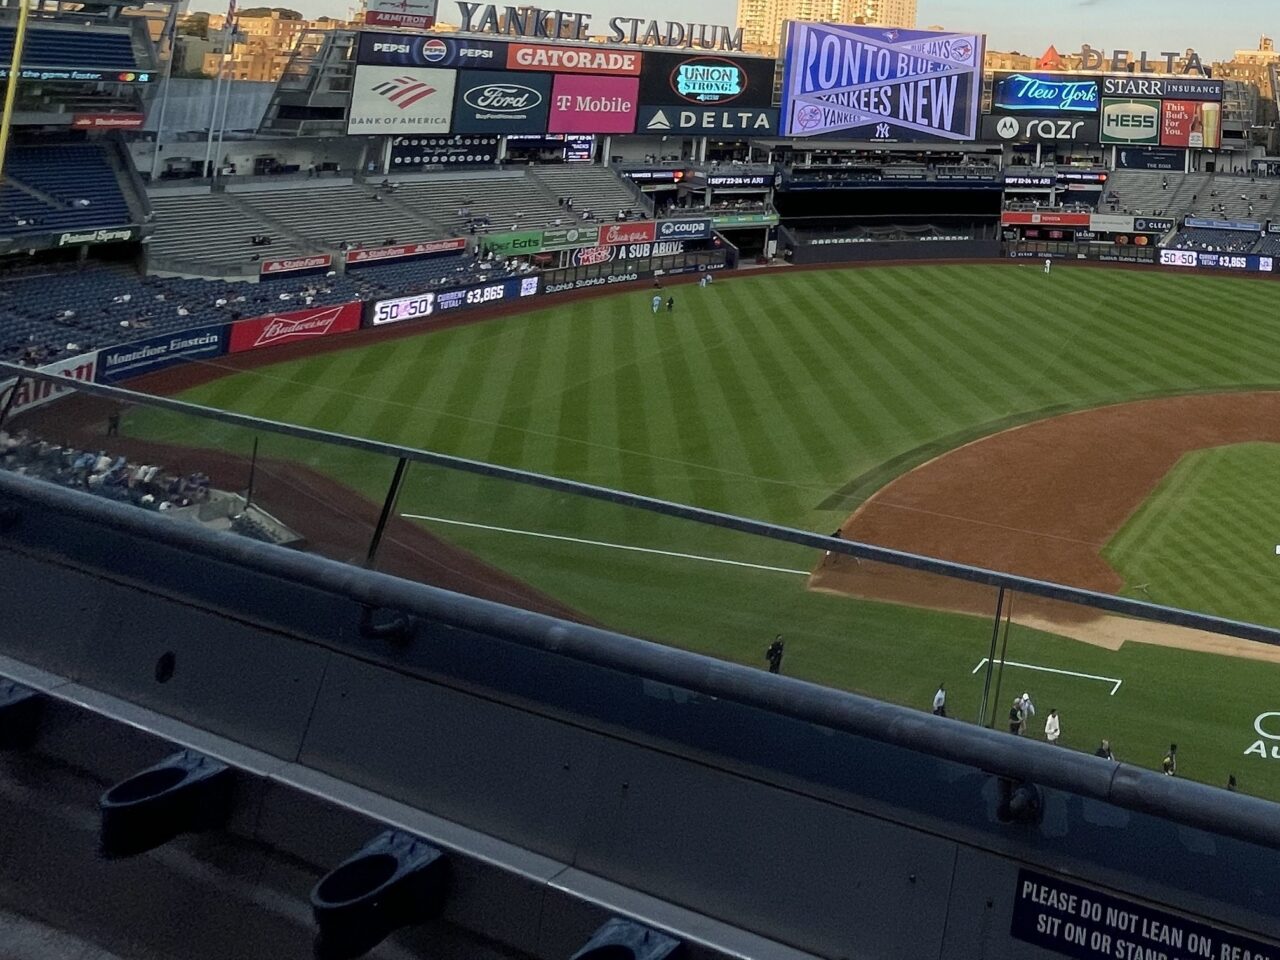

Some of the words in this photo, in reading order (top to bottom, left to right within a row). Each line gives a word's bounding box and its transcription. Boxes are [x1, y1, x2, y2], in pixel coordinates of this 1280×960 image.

[377, 13, 427, 23] ARMITRON
[454, 1, 593, 40] YANKEE
[608, 16, 744, 51] STADIUM
[373, 43, 410, 53] PEPSI
[460, 48, 493, 58] PEPSI
[927, 40, 950, 59] JAYS
[516, 48, 635, 70] GATORADE
[897, 53, 933, 77] BLUE
[1082, 48, 1206, 74] DELTA
[41, 72, 69, 80] game
[684, 68, 732, 81] UNION
[684, 82, 732, 91] STRONG!
[1015, 77, 1058, 98] New
[1061, 84, 1098, 108] York
[1104, 79, 1163, 95] STARR
[1168, 84, 1220, 94] INSURANCE
[477, 87, 529, 107] Ford
[557, 95, 571, 111] T
[575, 96, 631, 113] Mobile
[820, 86, 891, 116] YANKEES
[899, 75, 958, 131] NEW
[1165, 103, 1185, 111] This
[1165, 111, 1188, 120] Bud's
[680, 112, 770, 129] DELTA
[823, 107, 861, 127] YANKEES
[1107, 114, 1154, 128] HESS
[1026, 119, 1084, 139] razr
[1165, 127, 1183, 135] You.
[675, 222, 705, 233] coupa
[59, 231, 97, 246] Poland
[98, 229, 131, 242] Spring
[513, 238, 539, 249] Eats
[618, 246, 626, 260] A
[629, 243, 650, 258] SUB
[652, 240, 684, 255] ABOVE
[1164, 253, 1176, 263] 50
[1181, 254, 1194, 264] 50
[1219, 256, 1246, 268] $3,865
[545, 282, 574, 293] StubHub
[576, 278, 605, 287] StubHub
[608, 274, 637, 283] StubHub
[467, 285, 504, 303] $3,865
[379, 304, 398, 320] 50
[408, 301, 427, 316] 50
[267, 317, 333, 338] Budweiser
[106, 345, 168, 368] Montefiore
[170, 333, 219, 351] Einstein
[1022, 880, 1077, 915] PLEASE
[1080, 899, 1102, 922] DO
[1105, 907, 1139, 934] NOT
[1142, 918, 1183, 949] LEAN
[1187, 933, 1216, 960] ON,
[1221, 943, 1270, 960] REA
[1037, 914, 1062, 937] SIT
[1064, 923, 1087, 946] ON
[1091, 931, 1111, 955] OR
